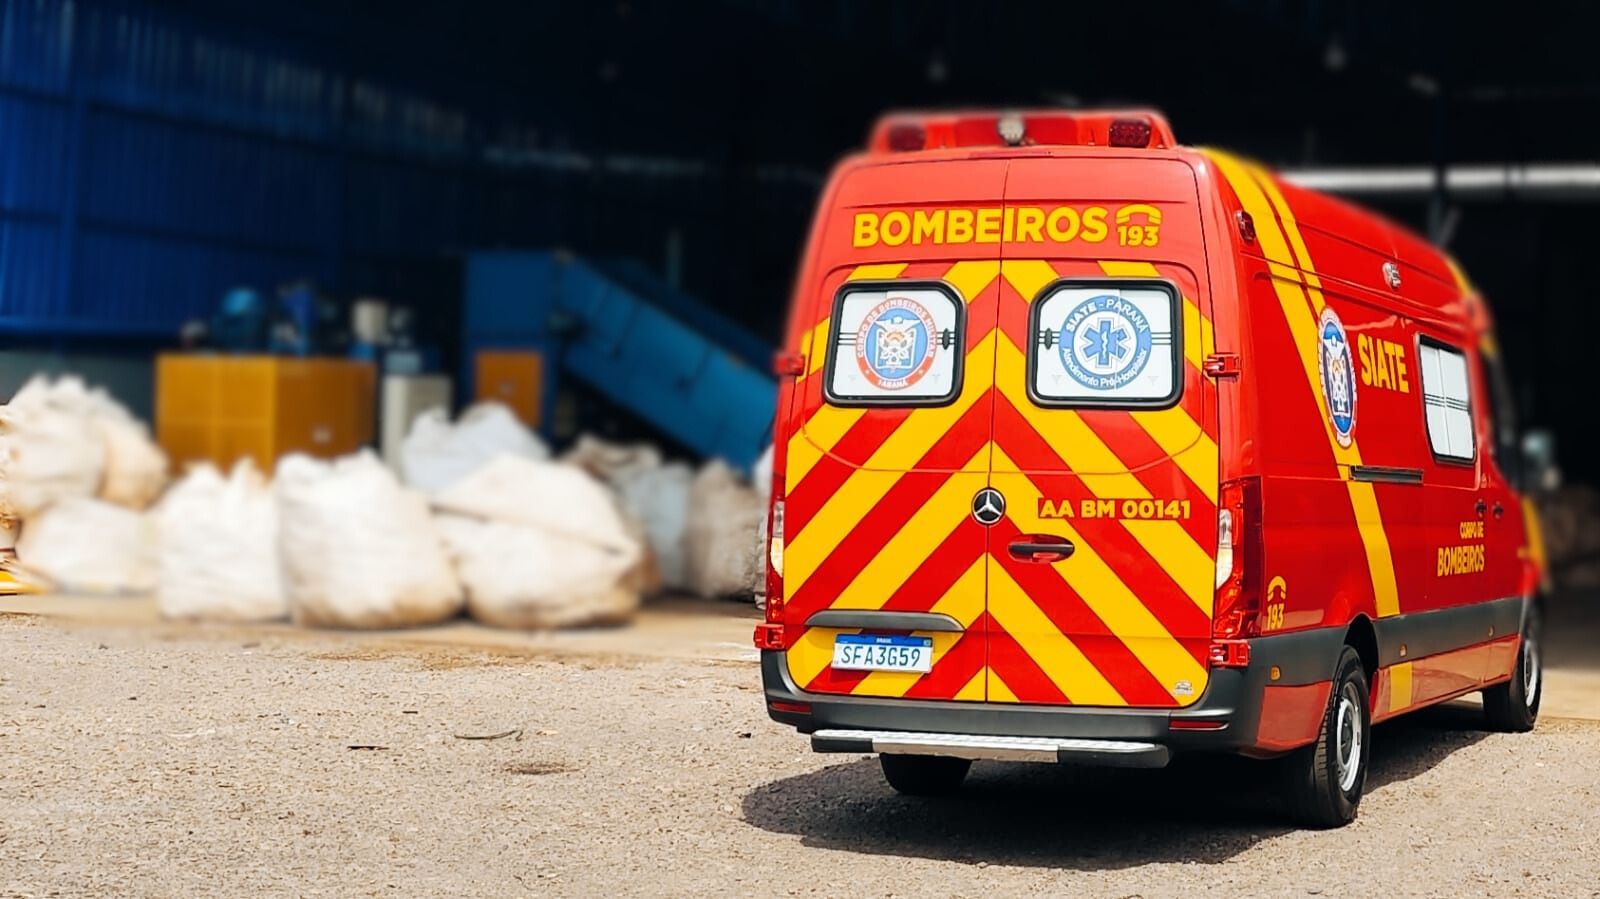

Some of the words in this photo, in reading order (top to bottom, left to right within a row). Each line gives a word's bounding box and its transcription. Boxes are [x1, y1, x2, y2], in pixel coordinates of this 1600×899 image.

[852, 207, 1108, 247] BOMBEIROS
[1117, 225, 1159, 247] 193
[1066, 302, 1098, 332] SIATE
[1357, 332, 1410, 394] SIATE
[1039, 500, 1075, 518] AA
[1081, 500, 1115, 518] BM
[1122, 500, 1191, 519] 00141
[1437, 543, 1485, 577] BOMBEIROS
[1267, 603, 1285, 631] 193
[841, 645, 921, 667] SFA3G59
